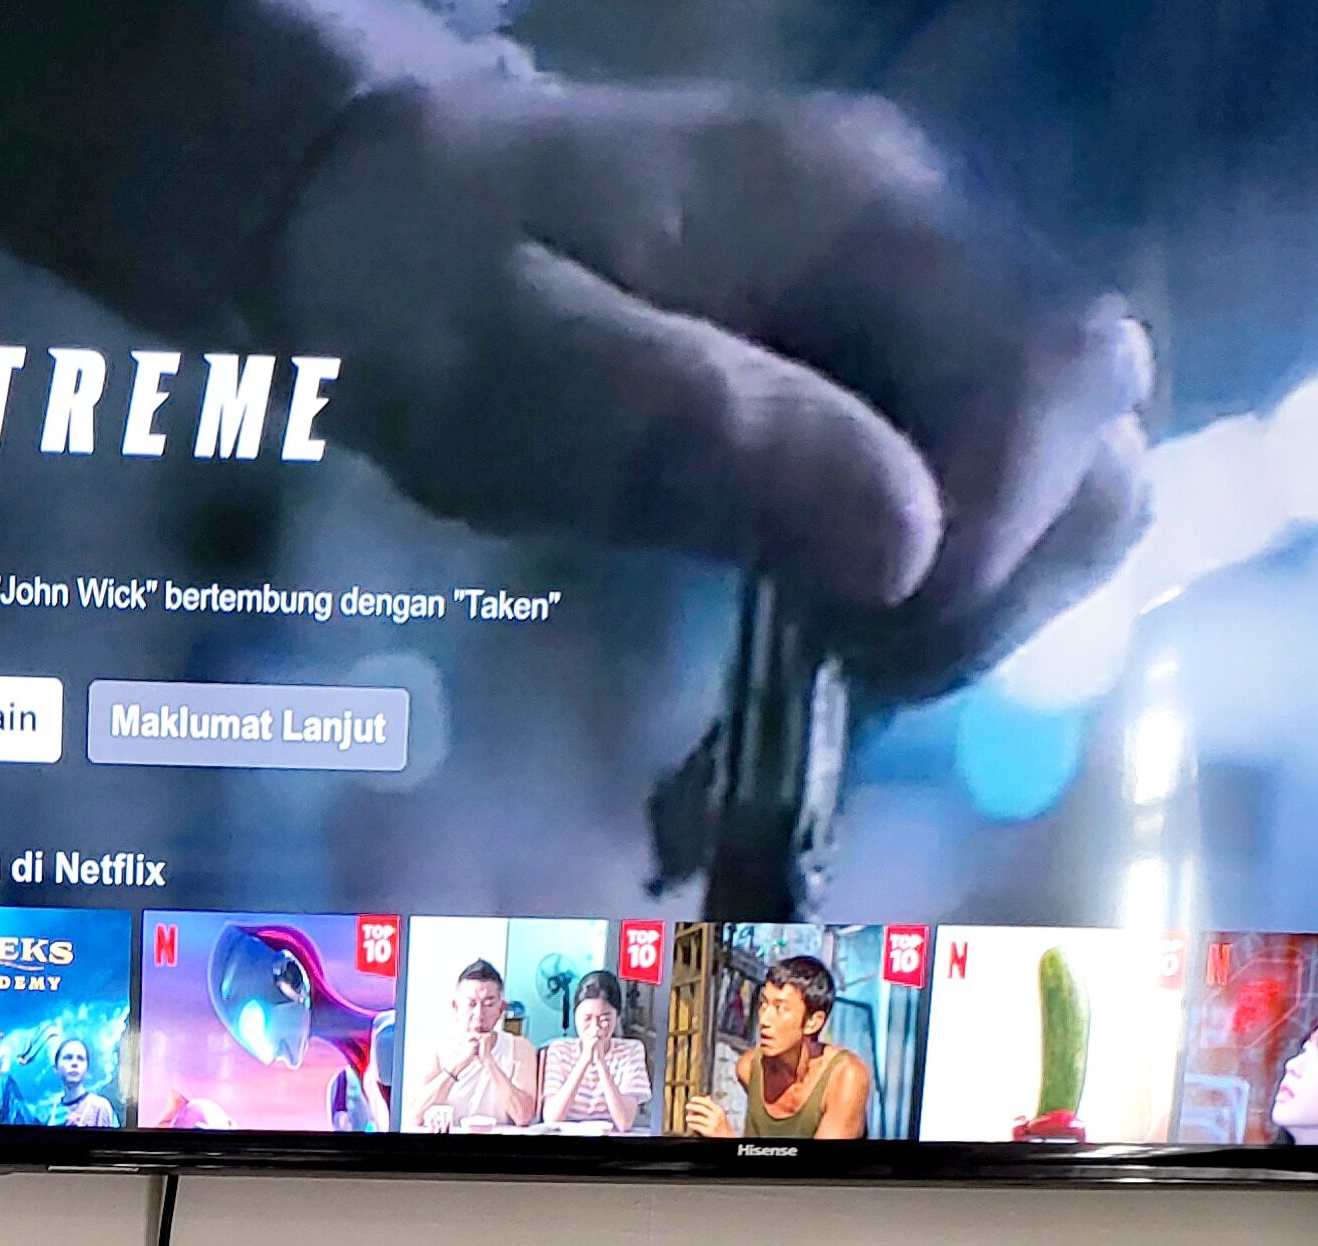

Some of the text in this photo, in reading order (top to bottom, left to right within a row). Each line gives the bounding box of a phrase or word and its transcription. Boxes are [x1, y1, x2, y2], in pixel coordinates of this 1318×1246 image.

[77, 576, 158, 610] Wick"
[165, 580, 331, 621] bertembung
[340, 585, 445, 624] dengan
[453, 588, 561, 622] "Taken"
[110, 702, 387, 751] Maklumat Lanjut
[11, 848, 43, 884] di
[55, 850, 167, 887] Netflix
[362, 924, 396, 940] TOP
[626, 929, 662, 945] TOP
[890, 933, 925, 950] TOP
[363, 941, 393, 964] 10
[627, 944, 657, 968] 10
[889, 949, 919, 973] 10
[737, 1144, 798, 1157] Hisense
